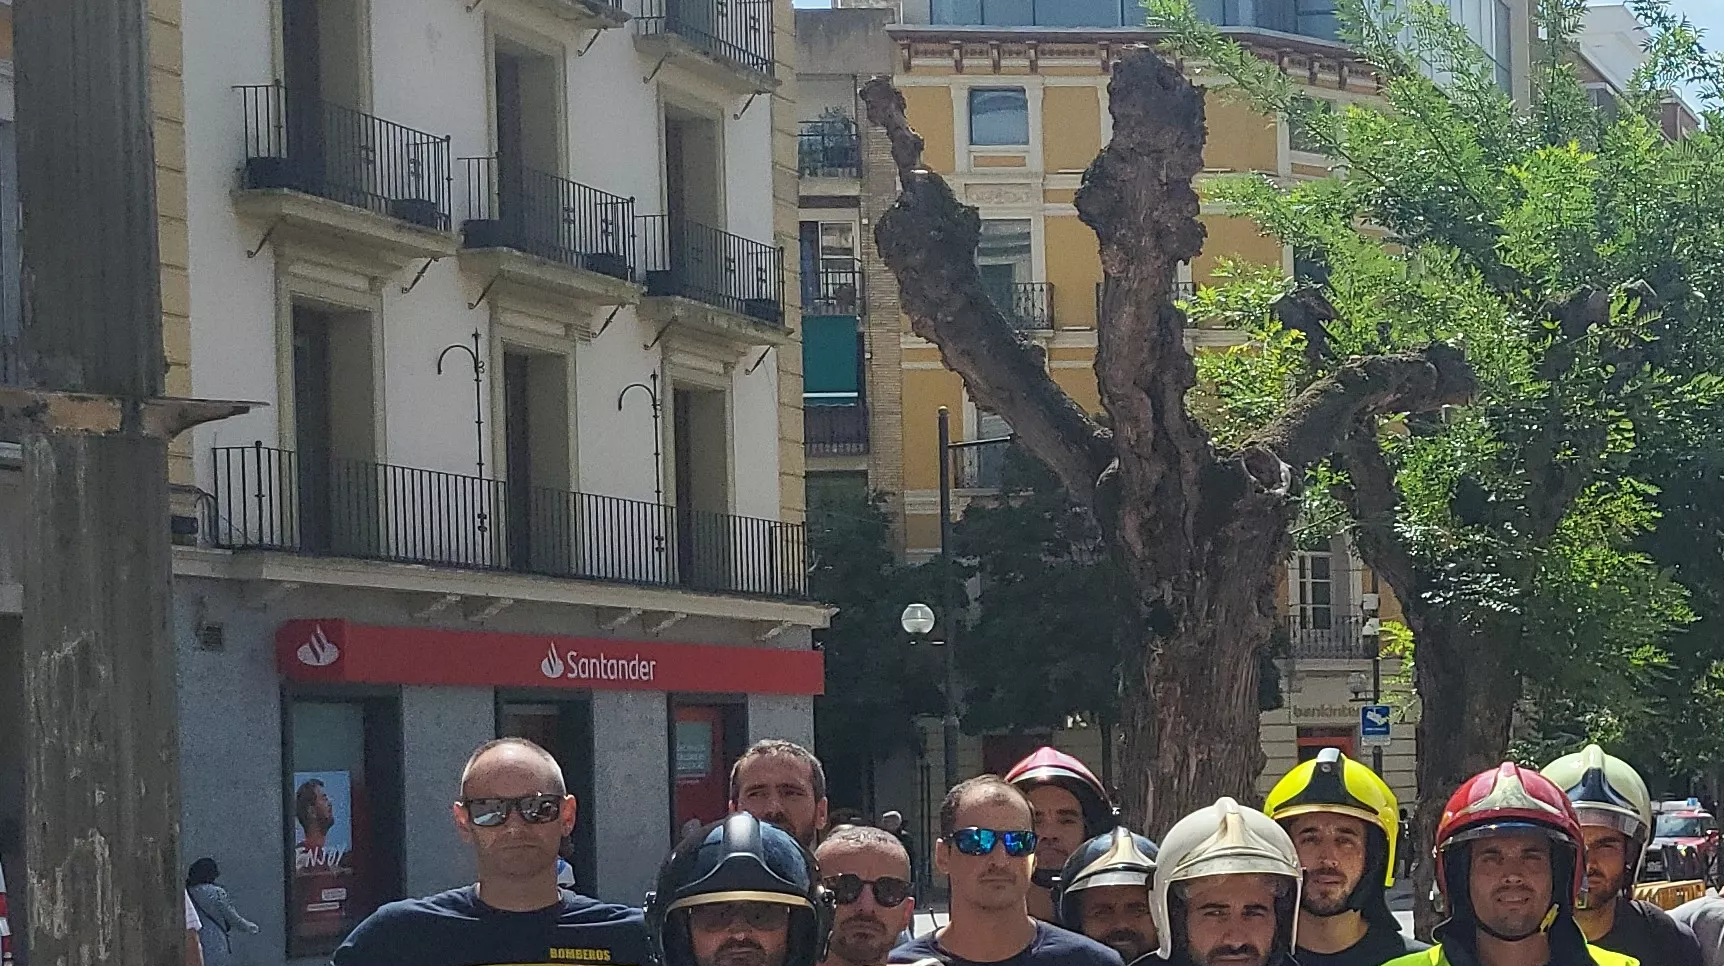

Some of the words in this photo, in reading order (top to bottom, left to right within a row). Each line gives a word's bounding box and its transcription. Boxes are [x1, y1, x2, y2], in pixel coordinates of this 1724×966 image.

[567, 651, 657, 681] Santander
[295, 846, 346, 870] ENJOY
[549, 947, 612, 961] BOMBEROS
